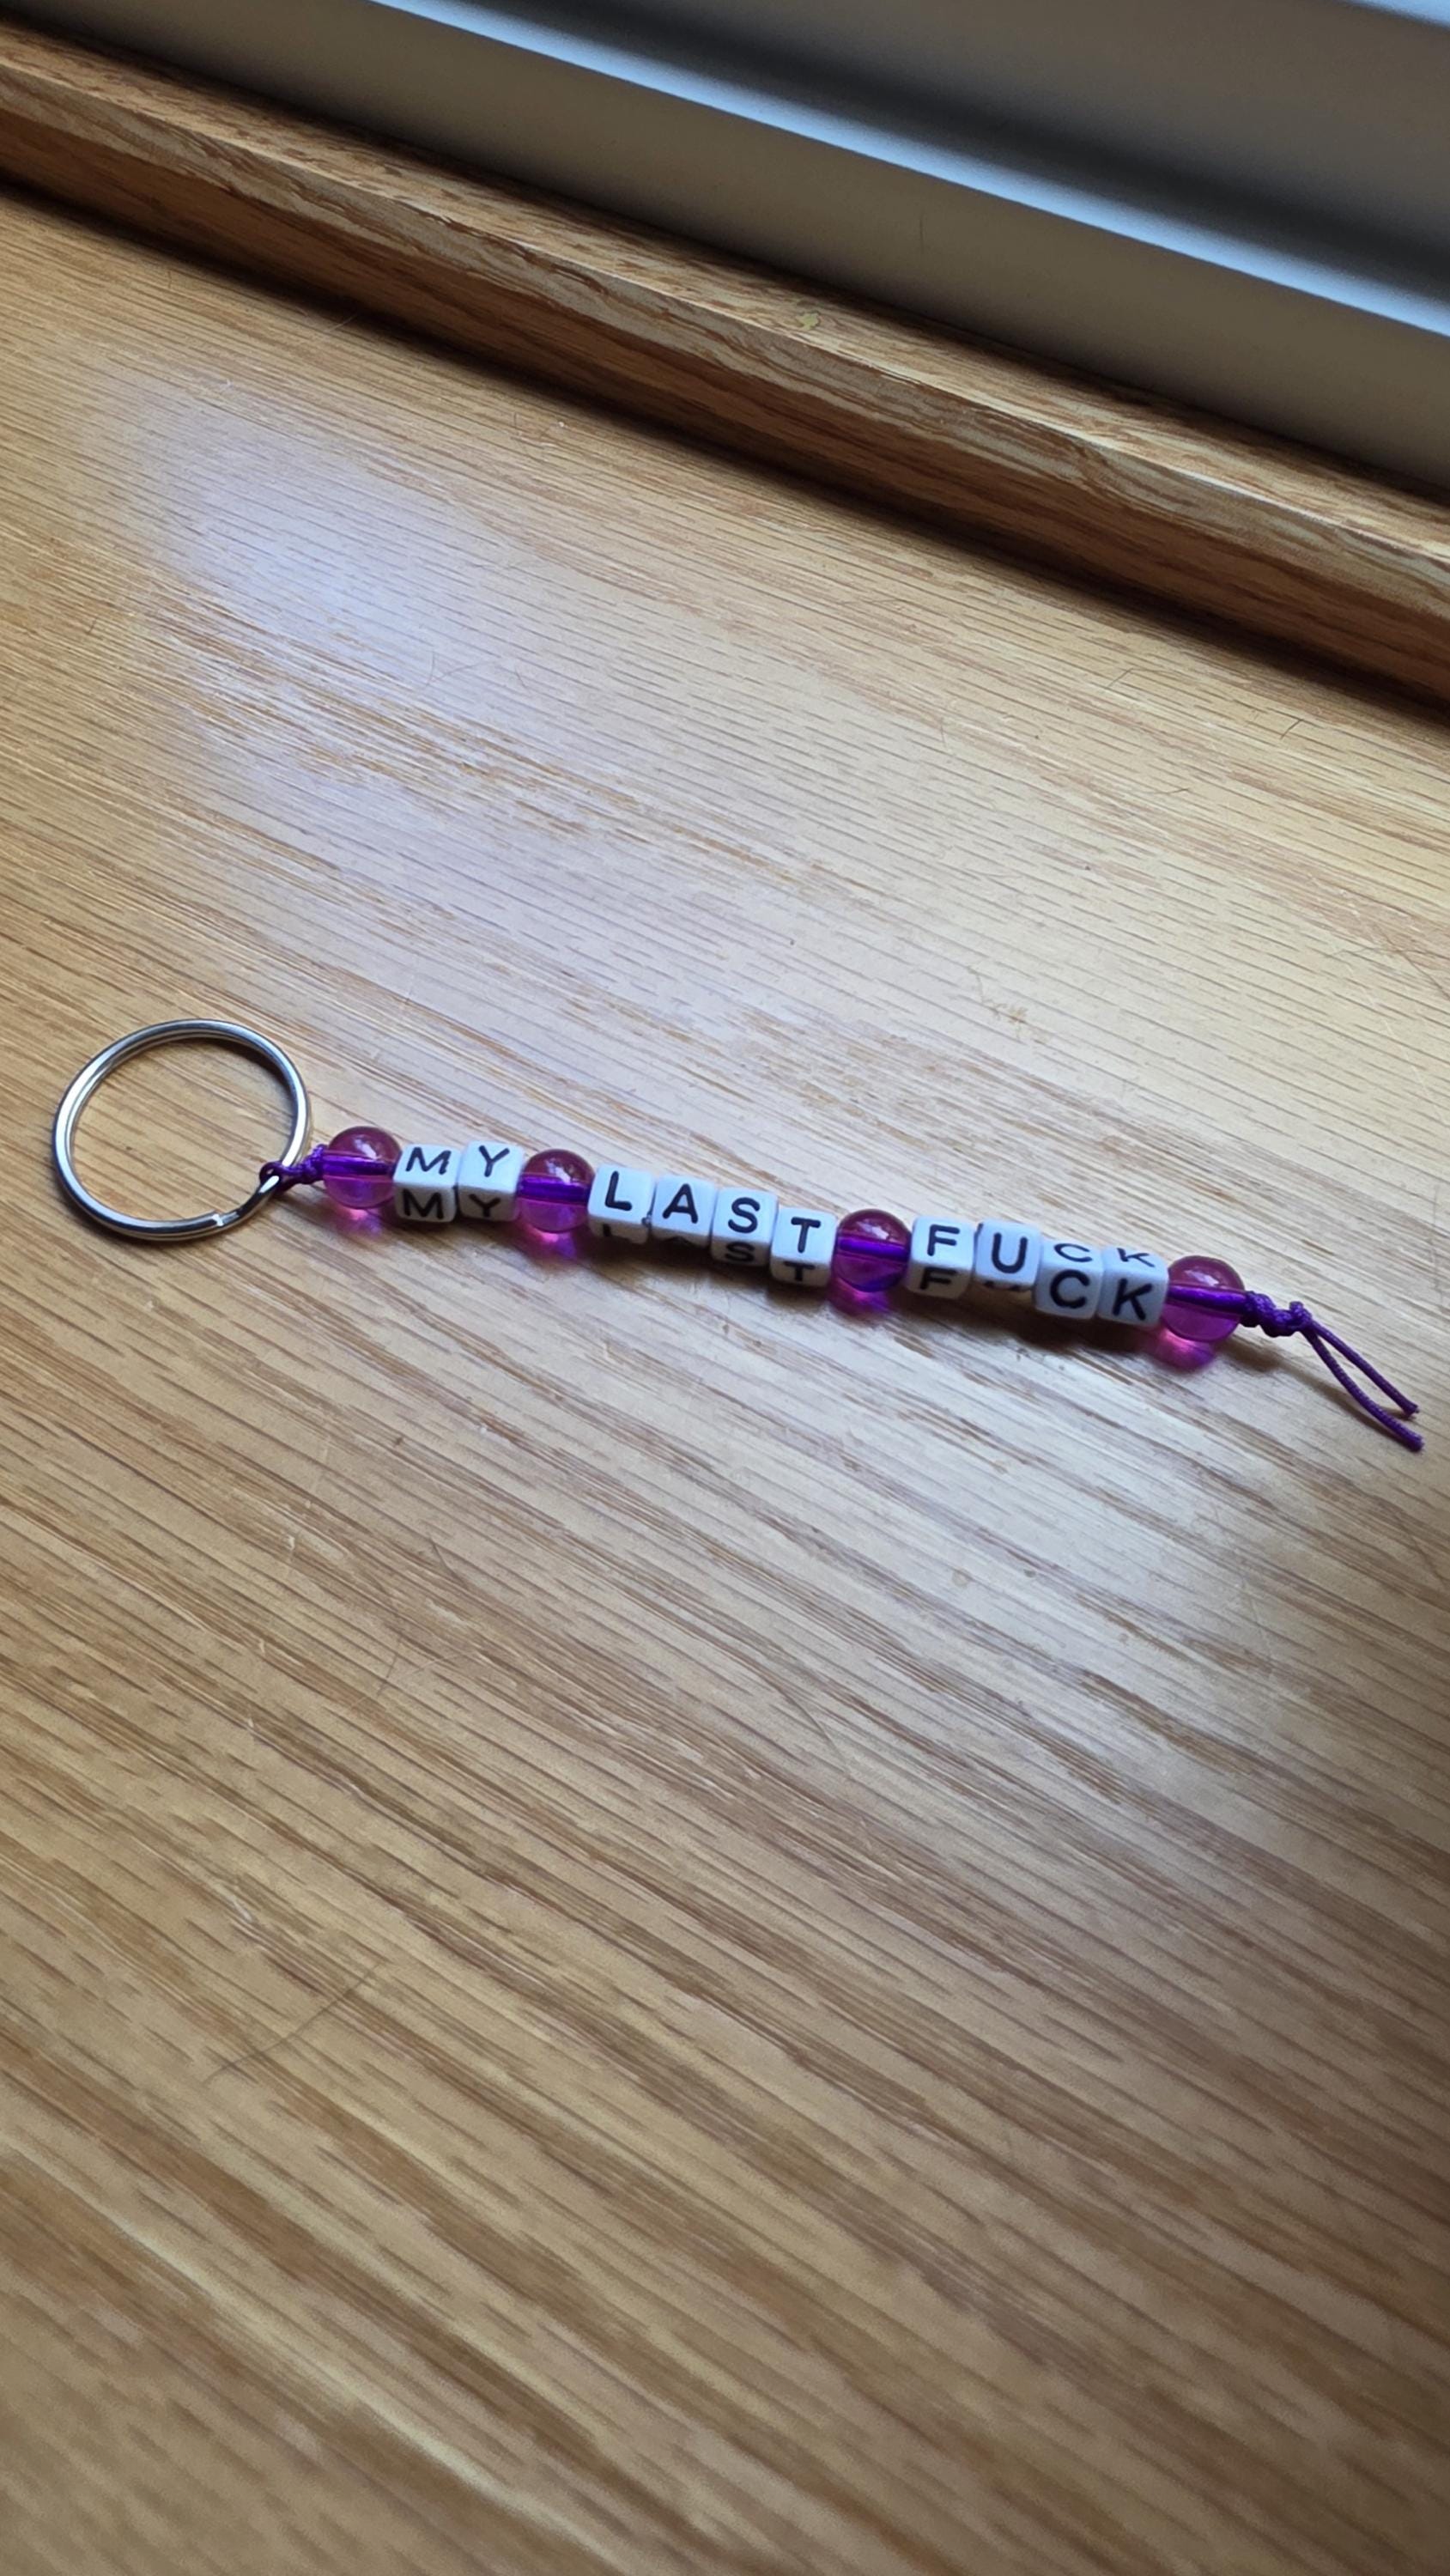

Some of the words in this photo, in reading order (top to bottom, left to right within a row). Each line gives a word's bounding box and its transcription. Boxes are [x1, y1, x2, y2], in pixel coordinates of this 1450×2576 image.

[401, 1188, 501, 1219] MY
[919, 1267, 1153, 1321] FCK
[404, 1145, 511, 1177] MY
[604, 1170, 822, 1254] LAST
[926, 1224, 1156, 1274] FUCK
